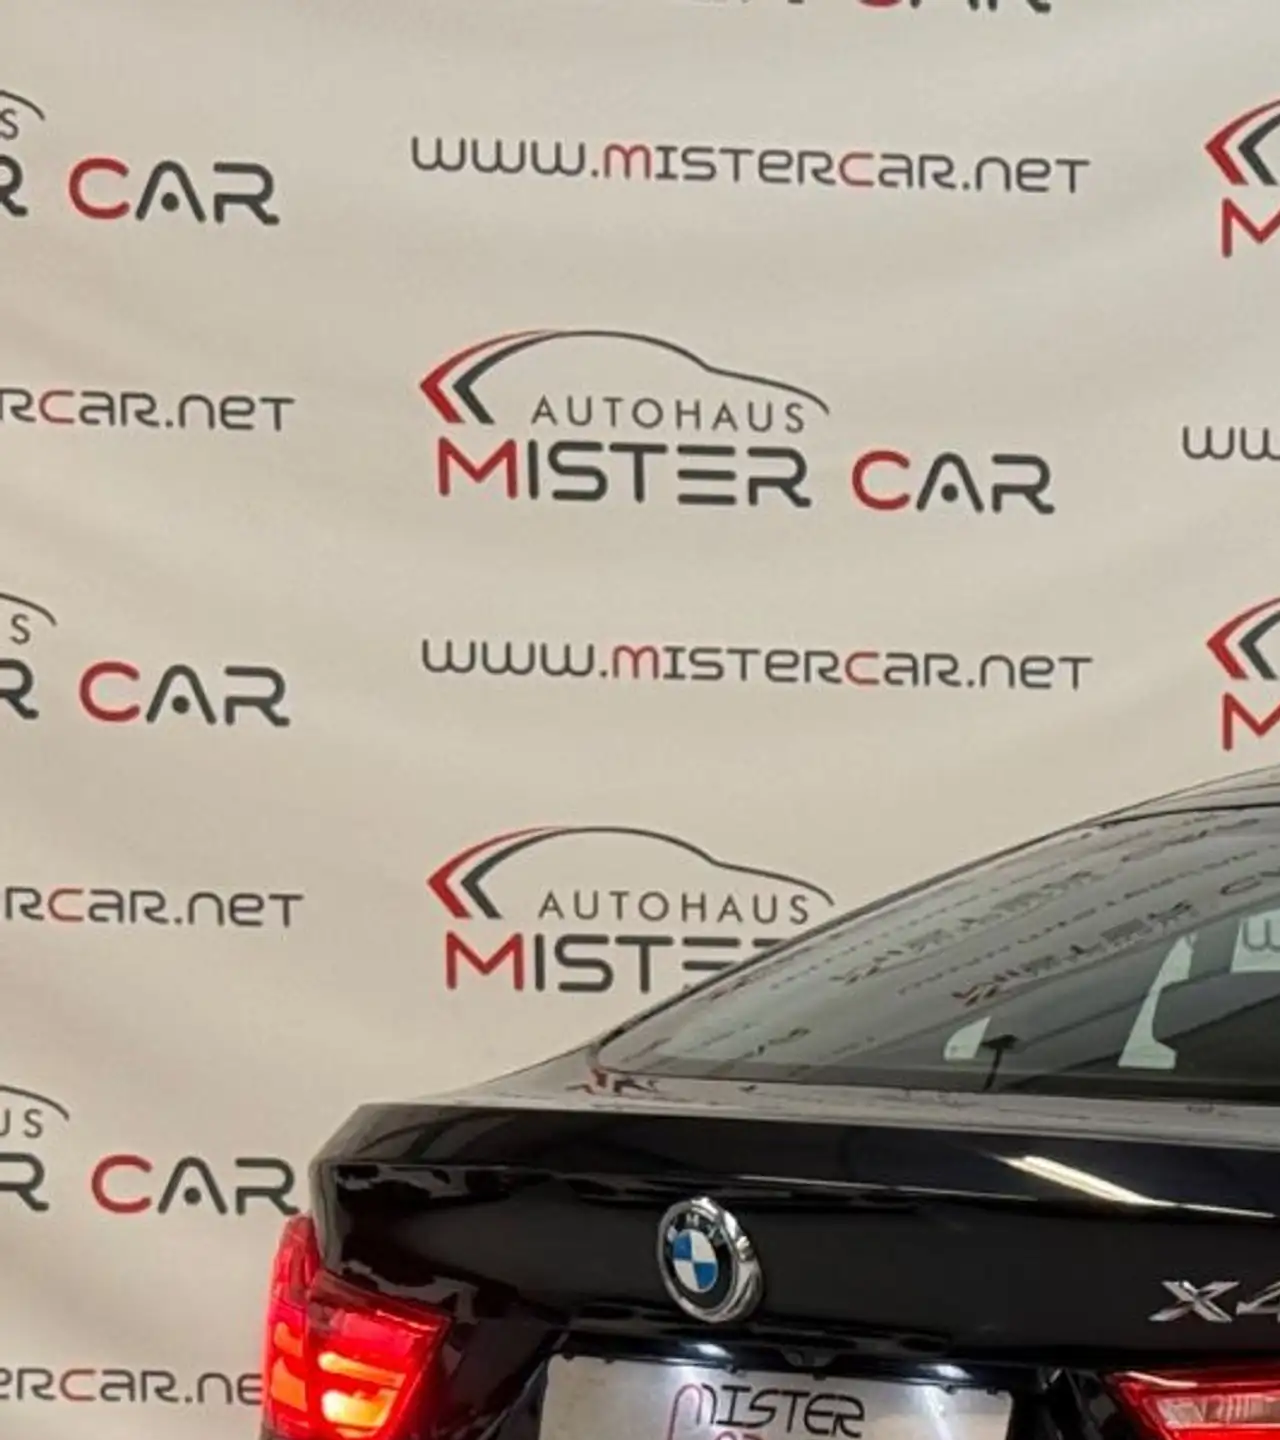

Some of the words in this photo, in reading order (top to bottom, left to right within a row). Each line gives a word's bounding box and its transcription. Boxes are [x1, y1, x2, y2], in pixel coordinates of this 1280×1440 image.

[67, 156, 282, 227] CAR
[530, 395, 806, 433] AUTOHAUS
[436, 435, 813, 509] MISTER
[850, 448, 1057, 516] CAR
[77, 660, 292, 729] CAR
[537, 889, 810, 926] AUTOHAUS
[444, 928, 790, 996] MISTE
[88, 1150, 301, 1218] CAR
[670, 1383, 866, 1440] MISTER
